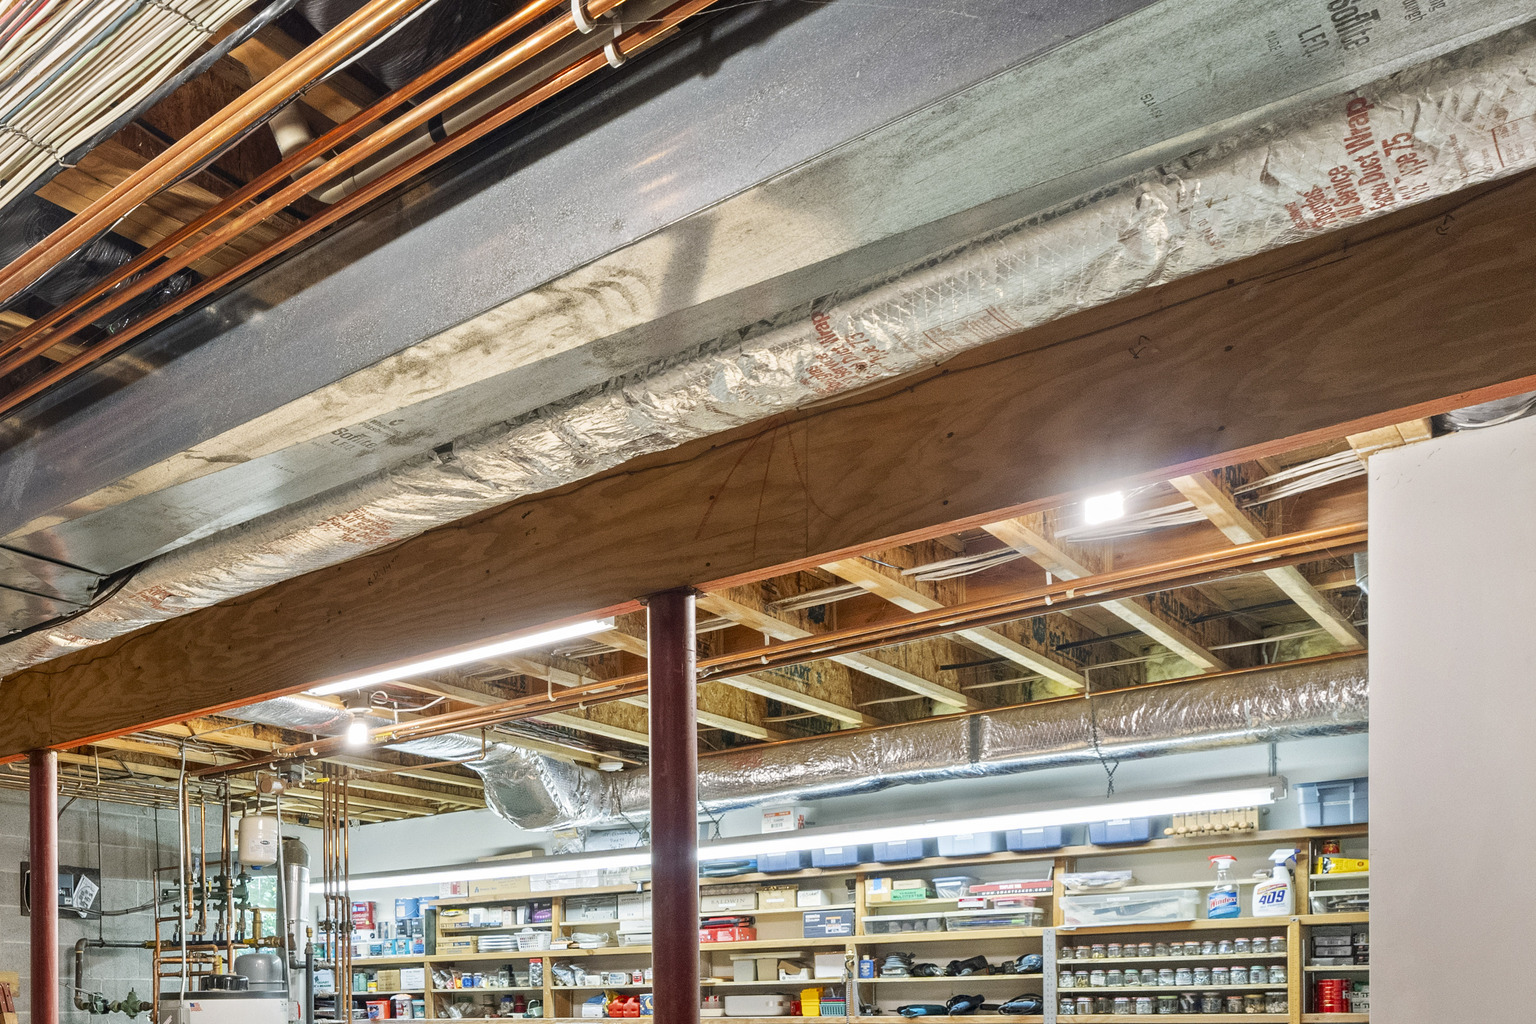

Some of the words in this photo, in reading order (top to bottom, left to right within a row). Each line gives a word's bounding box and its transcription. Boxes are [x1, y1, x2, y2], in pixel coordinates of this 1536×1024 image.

[1343, 97, 1376, 156] Wrap
[1381, 132, 1415, 158] 75
[1328, 165, 1362, 206] Service
[1354, 151, 1387, 187] Duct
[812, 311, 840, 347] Wrap
[1210, 897, 1236, 909] Windex
[1259, 890, 1285, 905] 409
